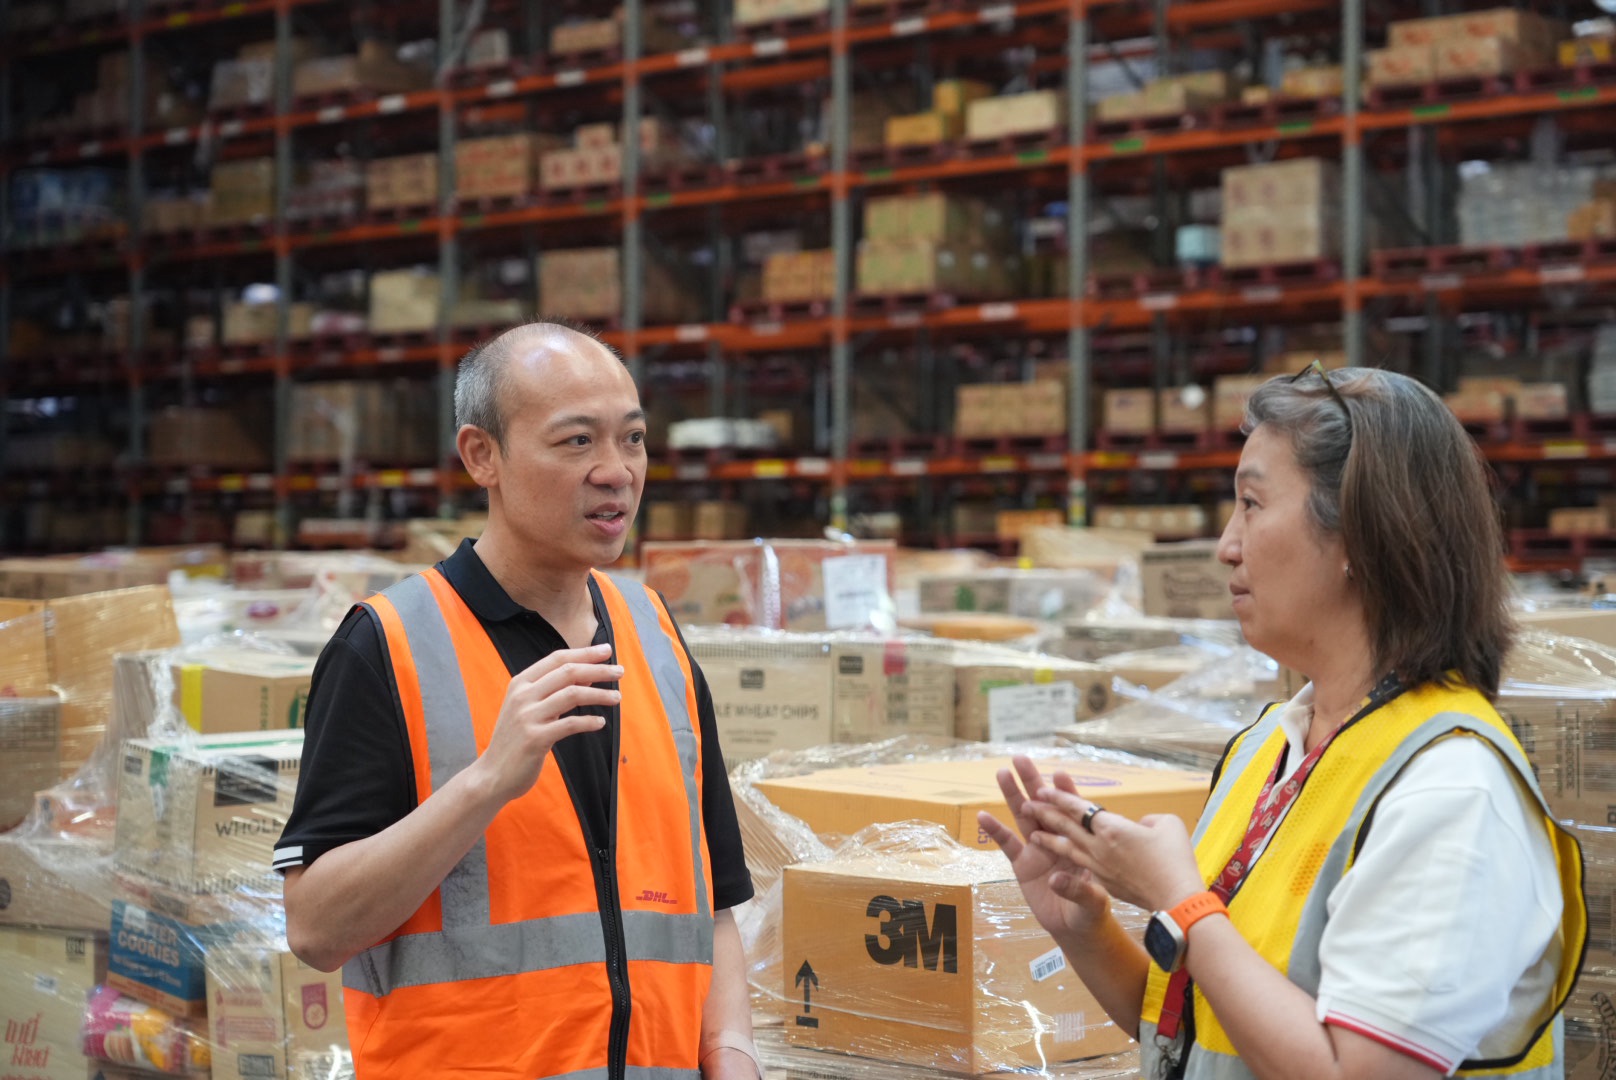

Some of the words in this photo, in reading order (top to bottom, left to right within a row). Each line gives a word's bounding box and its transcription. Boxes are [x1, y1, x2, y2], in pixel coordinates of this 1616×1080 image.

[735, 703, 778, 719] WHEAT
[781, 703, 819, 720] CHIPS
[215, 818, 281, 838] WHOLE
[636, 889, 677, 904] DHL
[865, 895, 958, 974] 3M
[118, 931, 180, 968] COOKIES
